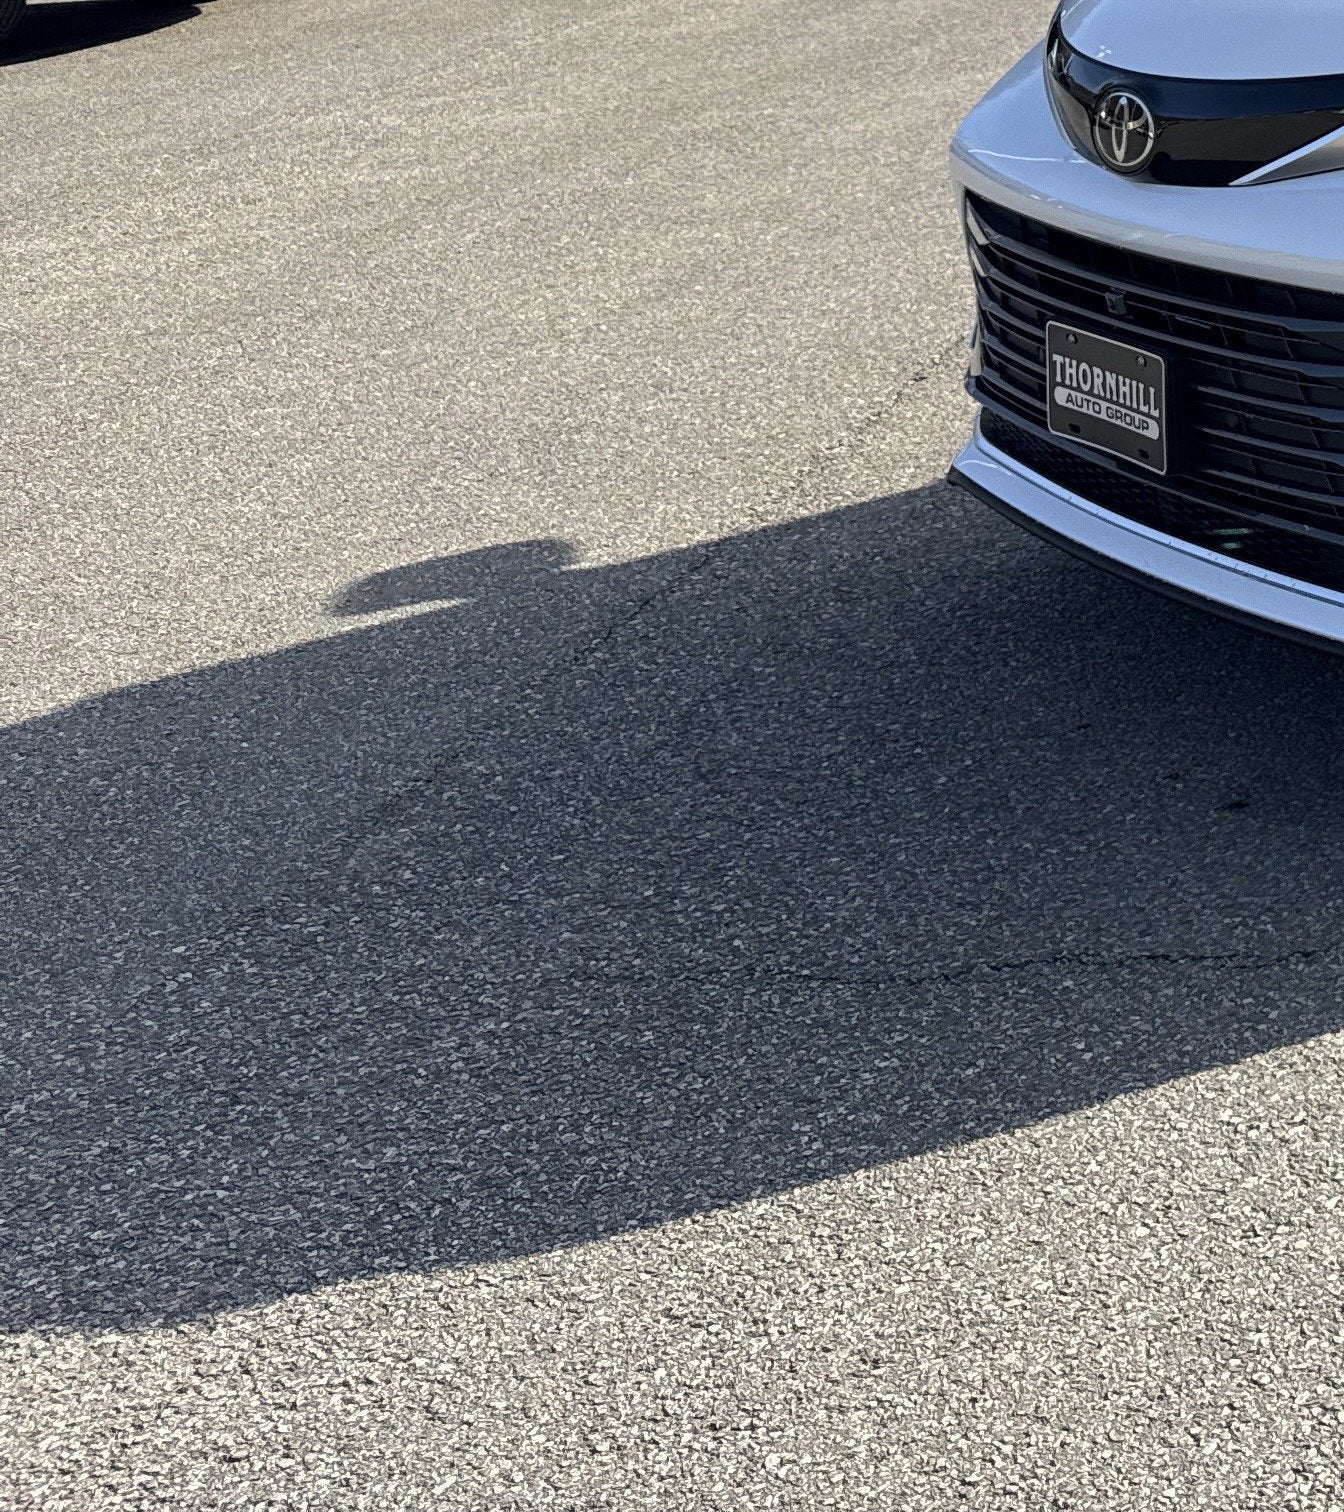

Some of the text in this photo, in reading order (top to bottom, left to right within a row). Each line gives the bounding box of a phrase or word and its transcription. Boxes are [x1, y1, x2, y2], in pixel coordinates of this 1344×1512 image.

[1052, 353, 1160, 418] THORNHILL
[1065, 392, 1150, 431] AUTO GROUP
